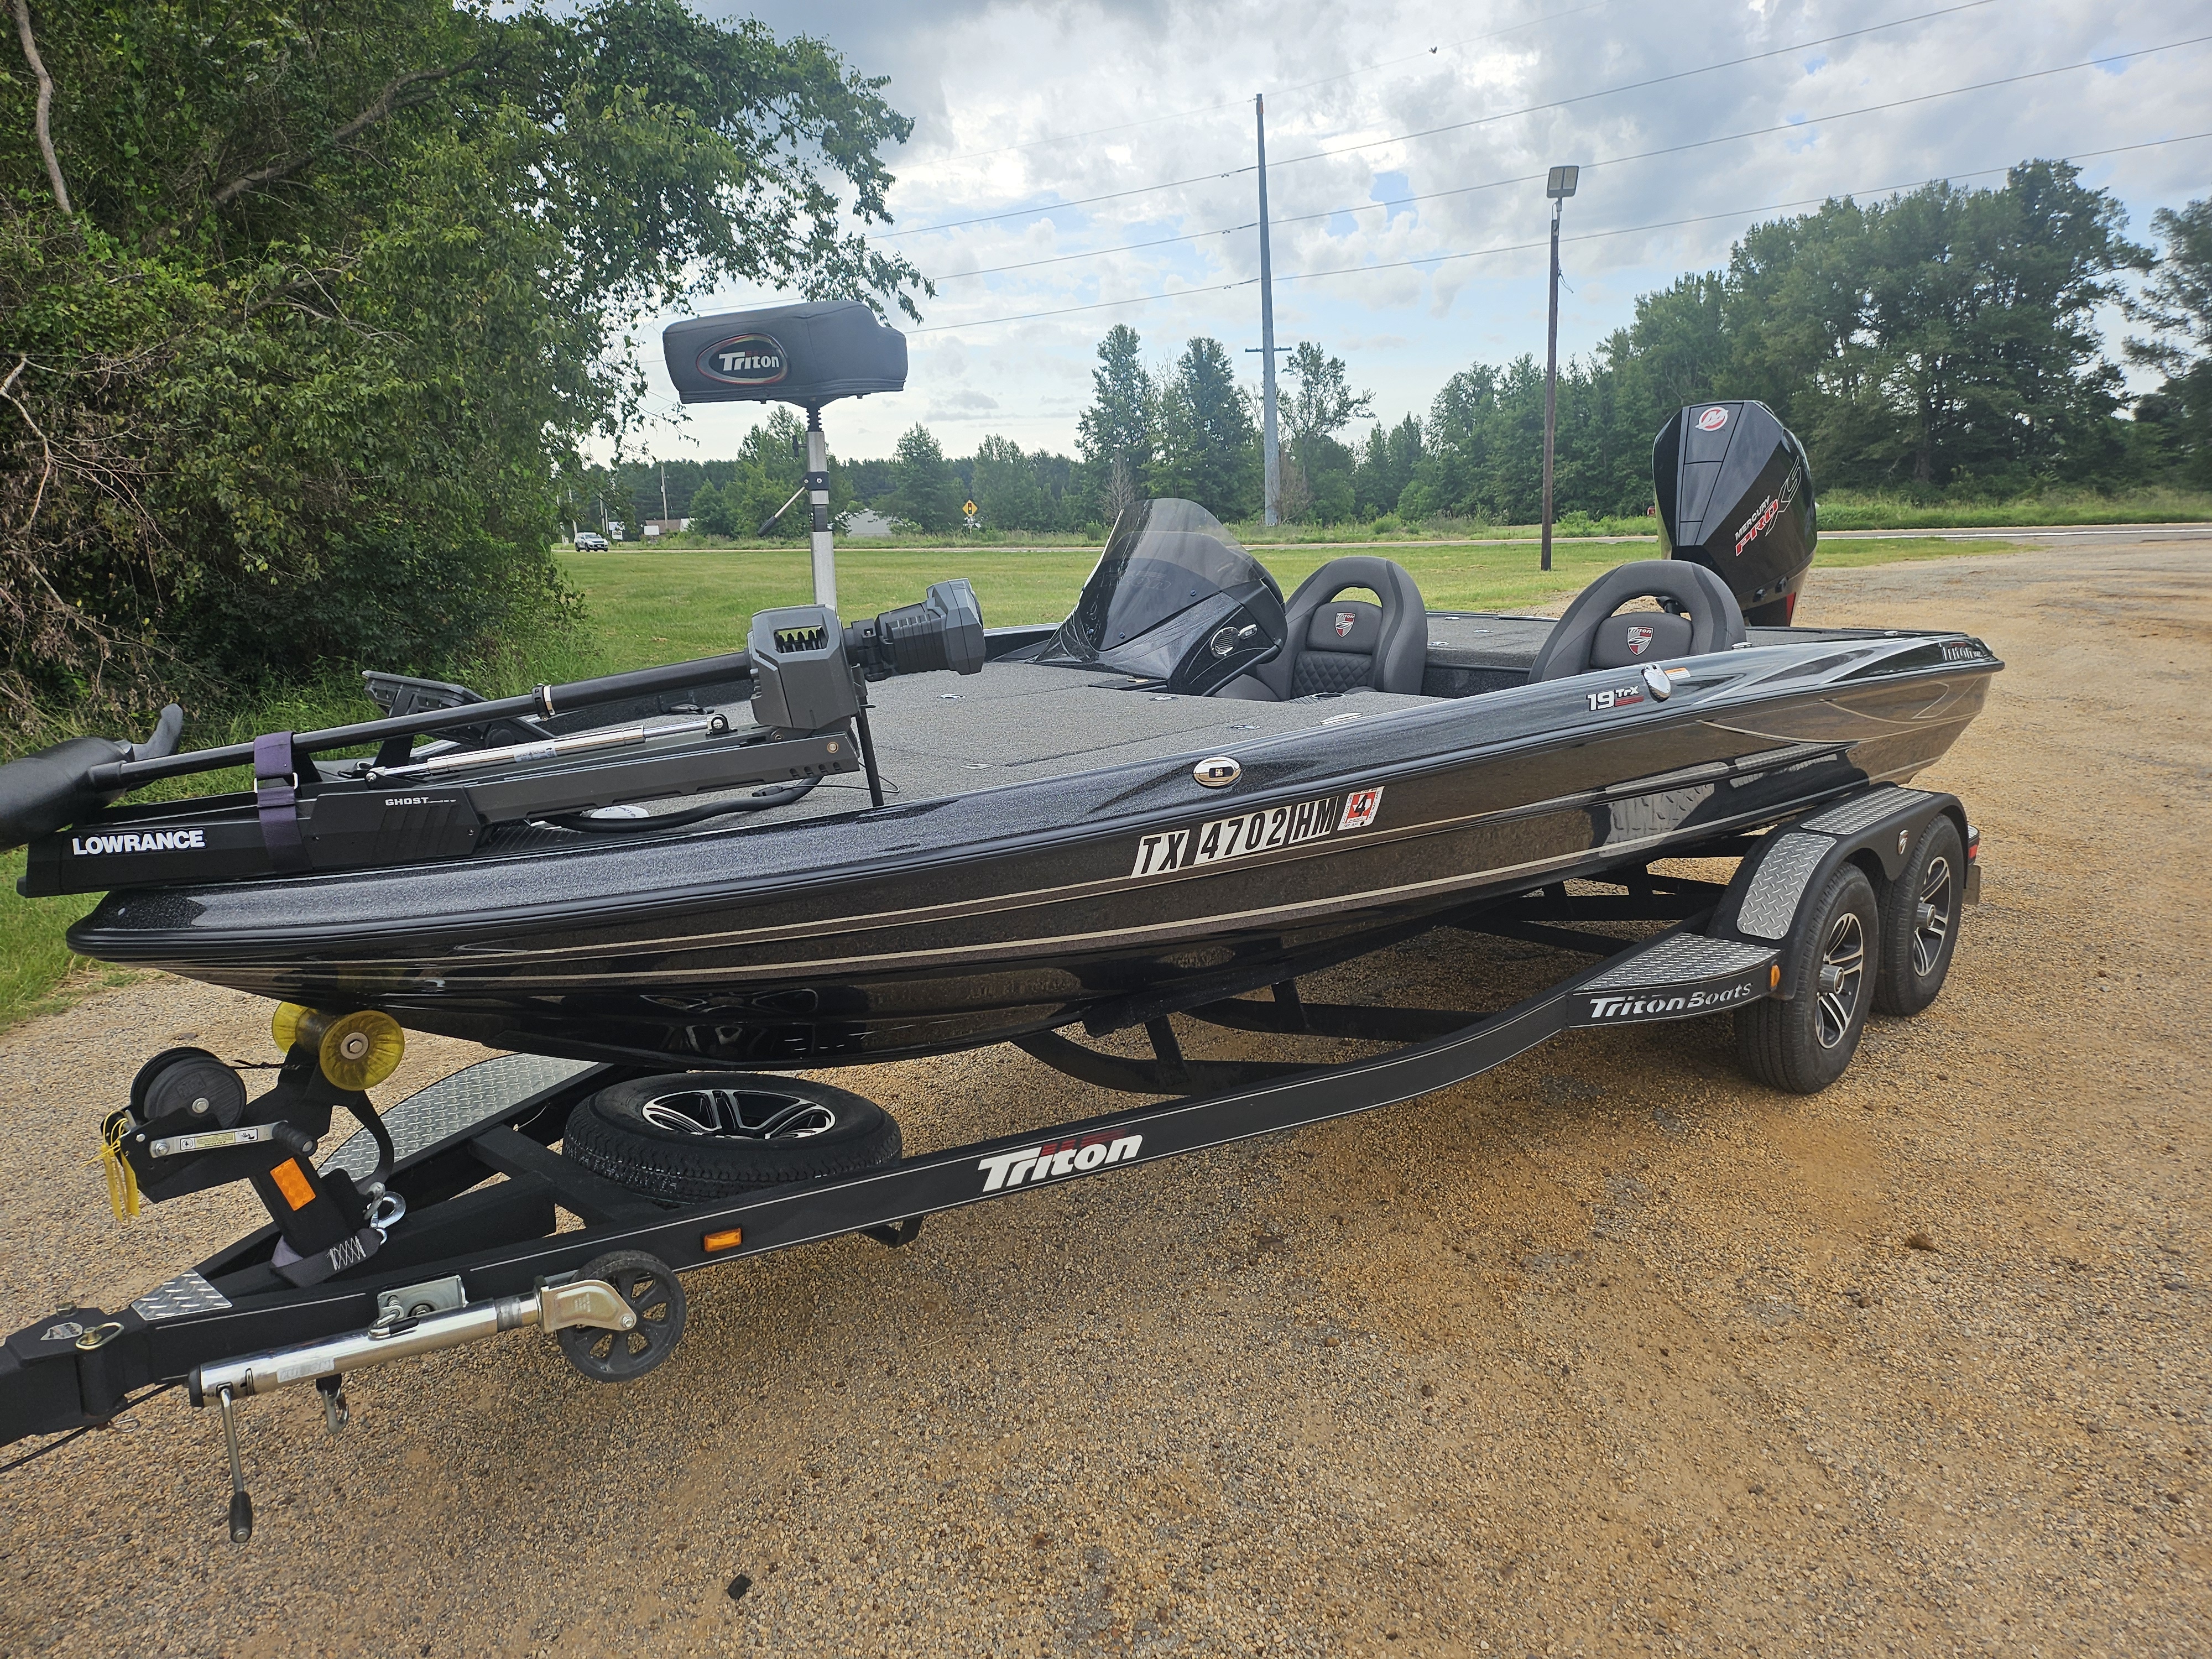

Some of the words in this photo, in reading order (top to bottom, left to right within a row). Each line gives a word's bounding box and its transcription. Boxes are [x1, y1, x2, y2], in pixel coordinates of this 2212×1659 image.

[719, 352, 780, 371] Triton
[1735, 495, 1770, 541] MERCURY
[1735, 499, 1778, 556] PRO
[1587, 691, 1615, 711] 19
[385, 797, 429, 806] GHOST
[1354, 794, 1368, 817] 4
[72, 830, 205, 855] LOWRANCE
[1140, 832, 1186, 874] TX
[1201, 807, 1287, 860] 4702
[1292, 796, 1338, 841] HM
[1589, 995, 1686, 1018] Triton
[1687, 983, 1752, 1009] Boats
[977, 1134, 1143, 1192] Triton
